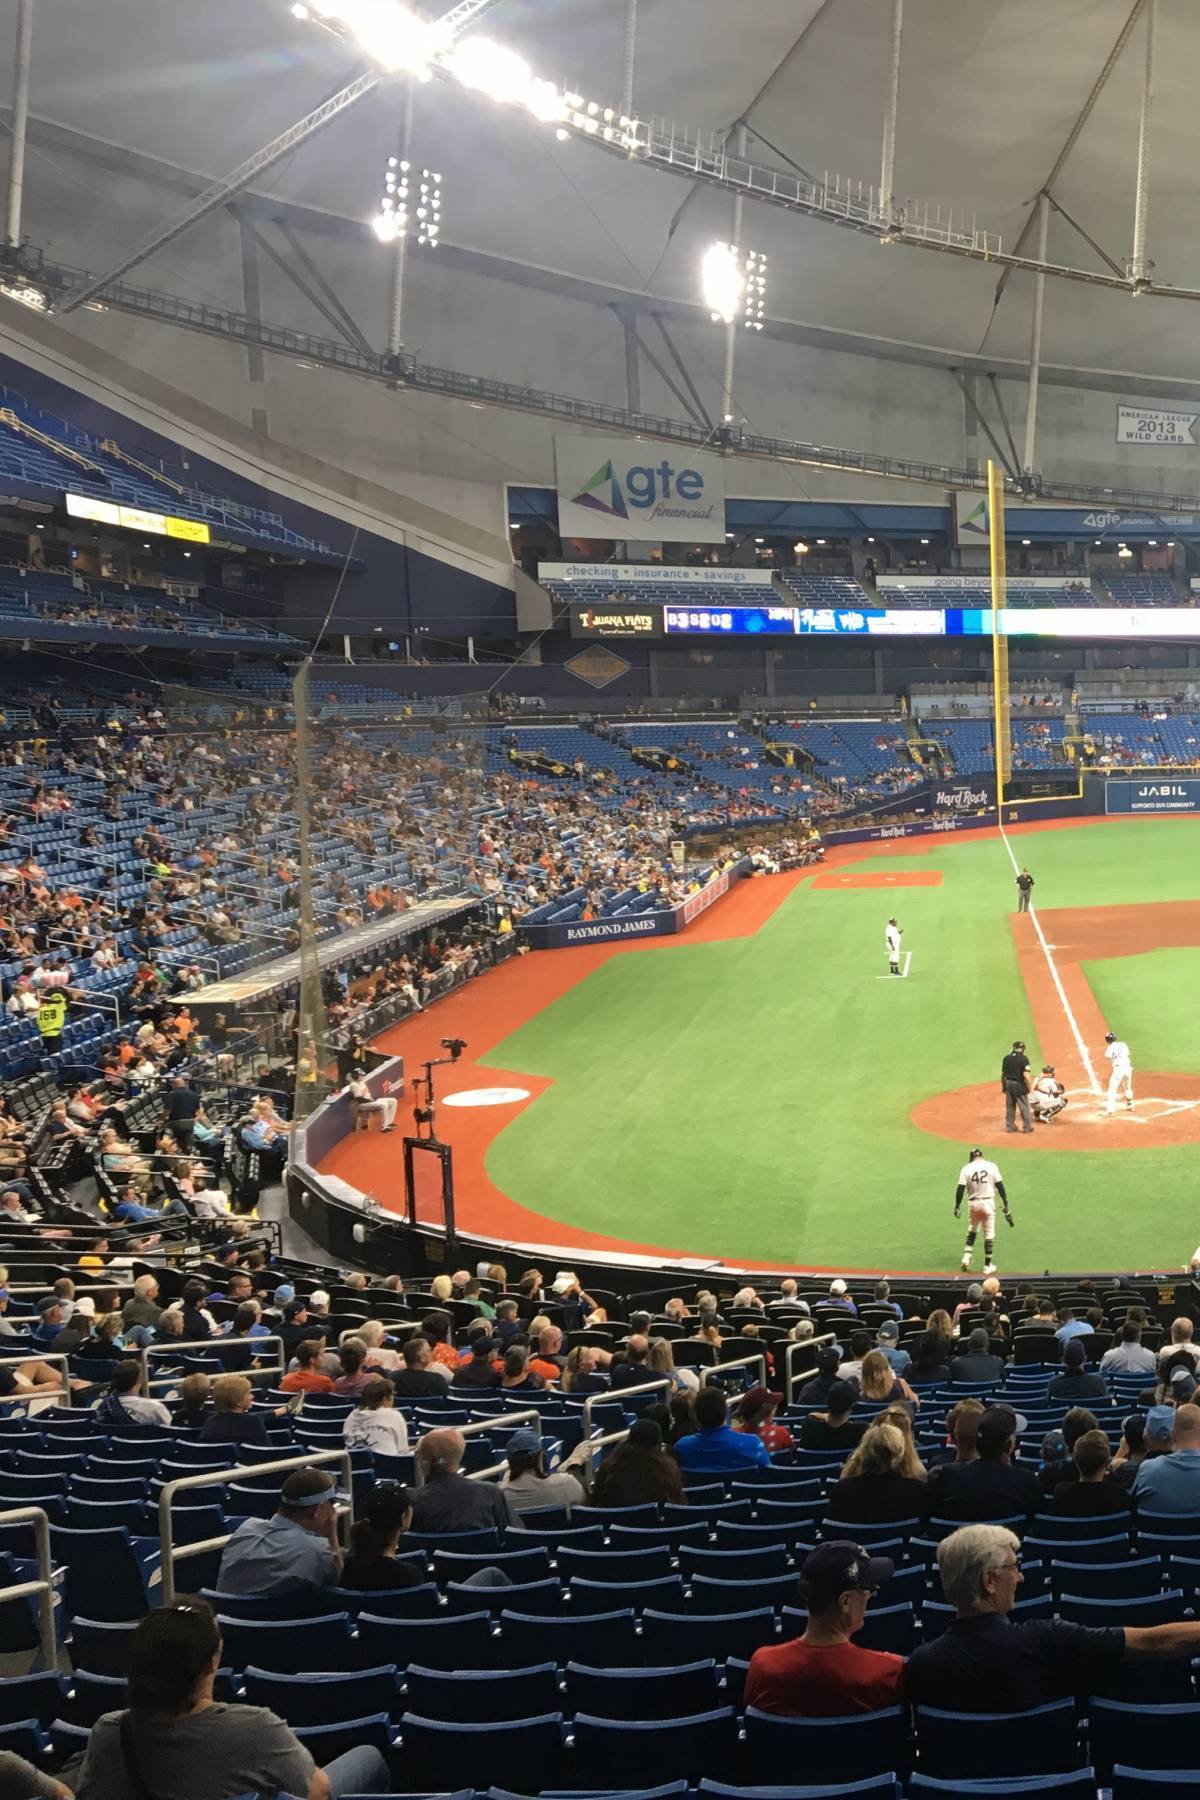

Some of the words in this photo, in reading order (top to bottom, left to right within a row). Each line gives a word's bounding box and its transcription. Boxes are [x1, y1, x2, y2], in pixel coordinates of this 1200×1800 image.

[1120, 411, 1159, 421] AMERICAN
[1163, 414, 1191, 423] LEAGUE
[1137, 420, 1176, 434] 2013
[1126, 431, 1151, 440] WILD
[1156, 433, 1184, 443] CARD
[626, 461, 704, 508] gte
[643, 503, 715, 521] financial
[1096, 513, 1120, 528] gte
[566, 565, 619, 579] checking
[633, 567, 690, 578] insurance
[703, 570, 746, 582] savings
[935, 578, 962, 588] going
[1005, 579, 1036, 588] money
[624, 614, 653, 627] FLATS
[936, 791, 962, 805] Hard
[963, 790, 988, 804] Rock
[1138, 785, 1187, 796] JABIL
[567, 922, 622, 940] RAYMOND
[622, 919, 656, 934] JAMES
[971, 1170, 988, 1184] 42
